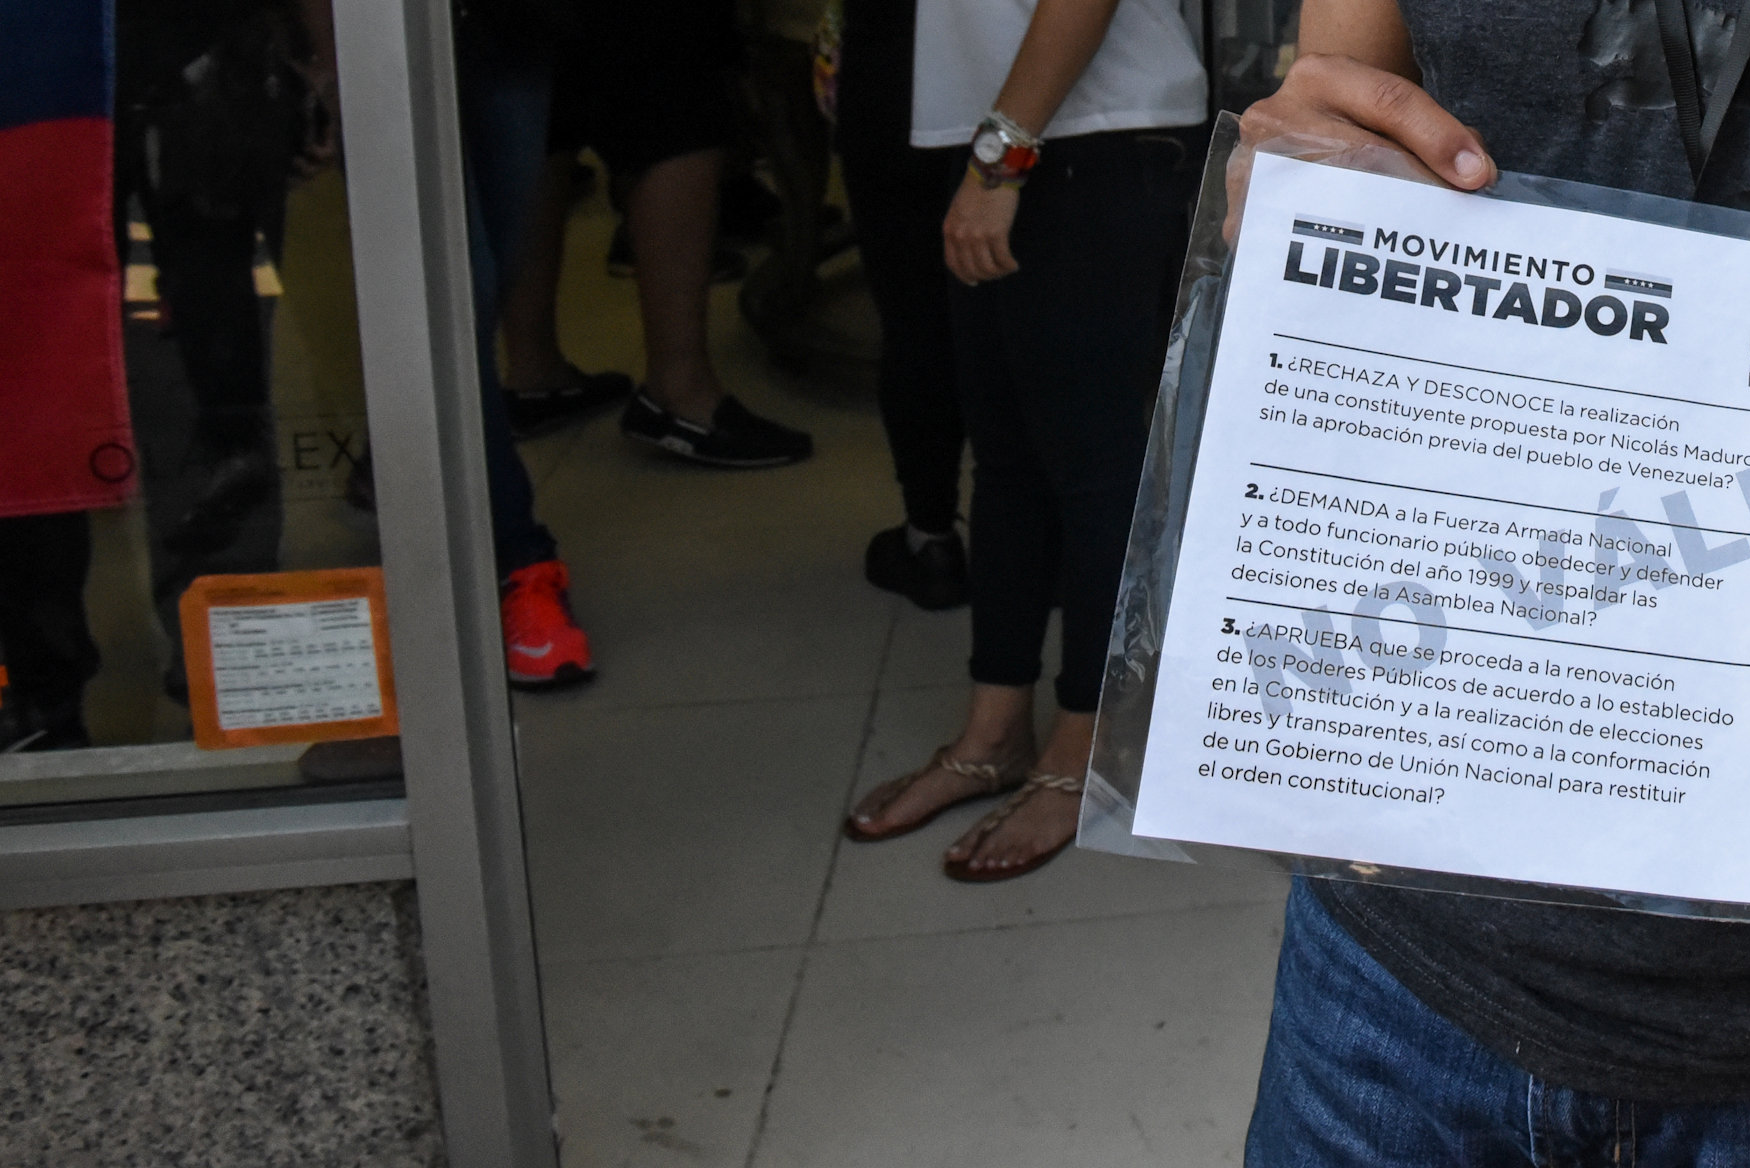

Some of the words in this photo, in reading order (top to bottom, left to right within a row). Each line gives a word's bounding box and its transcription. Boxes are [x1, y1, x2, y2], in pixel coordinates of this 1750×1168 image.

[1282, 239, 1671, 346] LIBERTADOR
[1373, 226, 1596, 287] MOVIMIENTO
[1263, 378, 1290, 397] de
[1293, 385, 1330, 404] una
[1333, 393, 1467, 427] constituyente
[1469, 415, 1569, 442] propuesta
[1572, 430, 1607, 447] por
[1610, 432, 1679, 458] Nicolás
[1268, 351, 1284, 370] 1.
[1287, 355, 1401, 390] ¿RECHAZA
[1406, 375, 1421, 393] Y
[1423, 378, 1556, 415] DESCONOCE
[1559, 399, 1576, 418] la
[1579, 406, 1680, 433] realización
[1258, 404, 1287, 424] sin
[1290, 407, 1309, 427] la
[1311, 415, 1424, 446] aprobación
[1427, 434, 1488, 456] previa
[1492, 441, 1523, 461] del
[1525, 449, 1594, 471] pueblo
[1597, 456, 1623, 475] de
[1627, 460, 1735, 490] Venezuela?
[1239, 512, 1254, 529] y
[1256, 514, 1270, 529] a
[1274, 514, 1322, 537] todo
[1326, 520, 1440, 553] funcionario
[1442, 539, 1518, 564] público
[1521, 549, 1616, 577] obedecer
[1619, 565, 1632, 582] y
[1635, 564, 1725, 591] defender
[1243, 482, 1266, 501] 2.
[1268, 486, 1390, 520] ¿DEMANDA
[1394, 508, 1407, 523] a
[1411, 506, 1429, 525] la
[1432, 509, 1501, 536] Fuerza
[1504, 520, 1584, 547] Armada
[1588, 531, 1673, 558] Nacional
[1230, 563, 1339, 594] decisiones
[1342, 578, 1369, 598] de
[1373, 581, 1390, 601] la
[1394, 585, 1496, 615] Asamblea
[1499, 598, 1598, 628] Nacional?
[1235, 534, 1253, 554] la
[1257, 538, 1386, 573] Constitución
[1389, 557, 1422, 578] del
[1424, 563, 1463, 584] año
[1467, 567, 1515, 590] 1999
[1517, 578, 1531, 595] y
[1534, 580, 1628, 605] respaldar
[1631, 589, 1658, 609] las
[1216, 644, 1244, 665] de
[1247, 648, 1278, 670] los
[1282, 653, 1367, 682] Poderes
[1371, 665, 1458, 693] Públicos
[1461, 676, 1489, 697] de
[1491, 683, 1576, 708] acuerdo
[1579, 695, 1592, 710] a
[1596, 692, 1615, 713] lo
[1618, 699, 1735, 727] establecido
[1219, 616, 1242, 637] 3.
[1245, 620, 1364, 653] ¿APRUEBA
[1368, 640, 1409, 659] que
[1411, 646, 1436, 662] se
[1438, 649, 1524, 673] proceda
[1527, 660, 1540, 675] a
[1544, 658, 1562, 678] la
[1565, 665, 1676, 693] renovación
[1206, 700, 1264, 726] libres
[1266, 712, 1282, 731] y
[1285, 711, 1433, 749] transparentes,
[1437, 731, 1468, 751] así
[1470, 737, 1529, 758] como
[1532, 745, 1545, 760] a
[1549, 742, 1567, 763] la
[1570, 750, 1711, 780] conformación
[1211, 676, 1237, 693] en
[1241, 675, 1260, 696] la
[1264, 680, 1396, 713] Constitución
[1399, 700, 1414, 718] y
[1416, 702, 1430, 717] a
[1433, 700, 1452, 720] la
[1455, 706, 1564, 734] realización
[1568, 718, 1595, 738] de
[1598, 722, 1704, 751] elecciones
[1198, 760, 1217, 778] el
[1220, 765, 1283, 787] orden
[1287, 772, 1446, 806] constitucional?
[1202, 730, 1230, 751] de
[1233, 737, 1260, 755] un
[1265, 737, 1363, 767] Gobierno
[1367, 750, 1395, 771] de
[1399, 753, 1460, 779] Unión
[1464, 761, 1554, 790] Nacional
[1557, 777, 1604, 796] para
[1608, 783, 1687, 805] restituir
